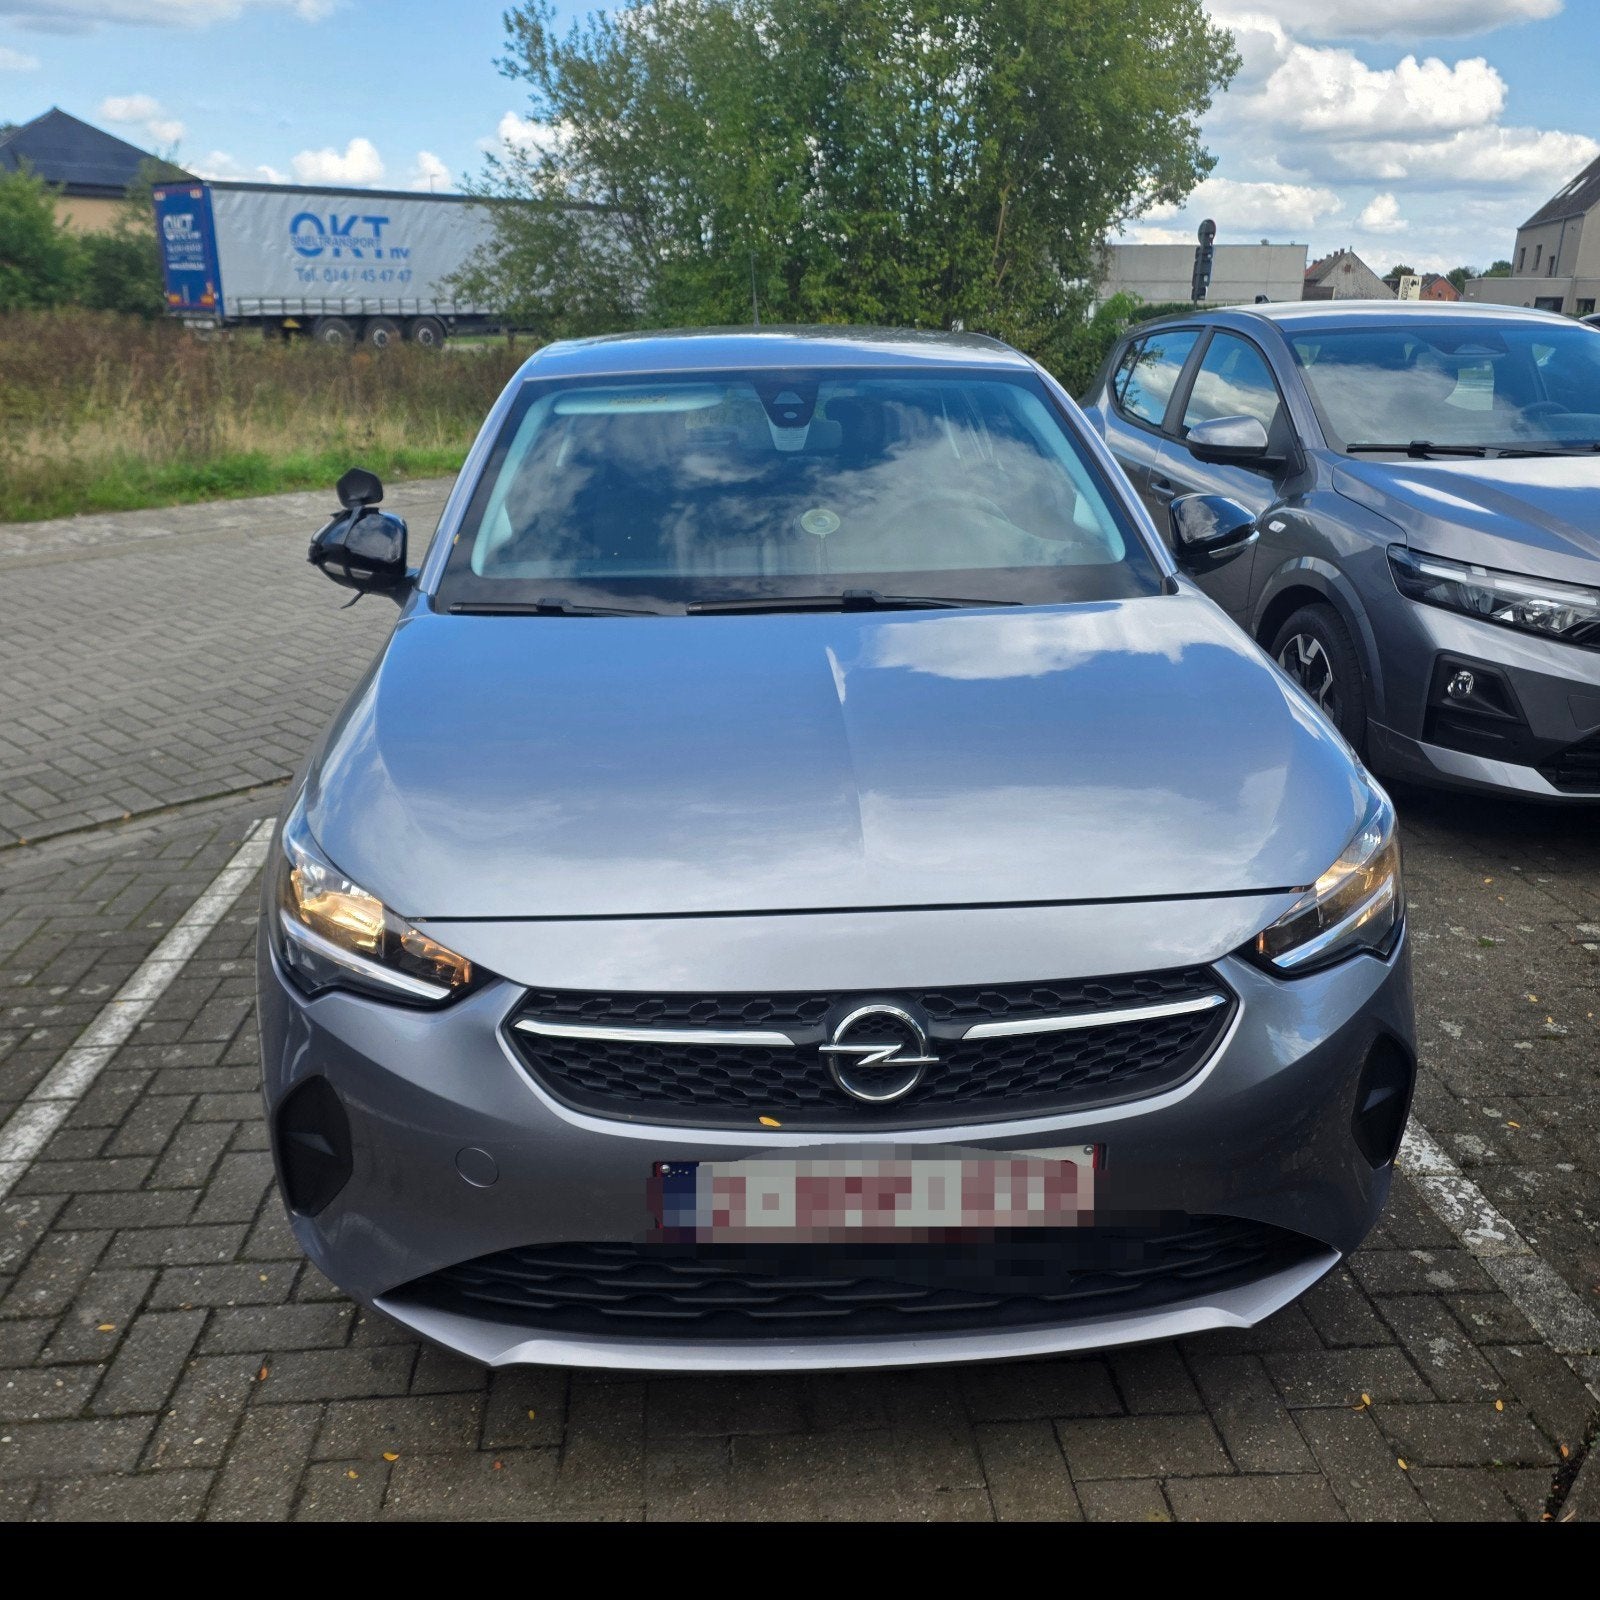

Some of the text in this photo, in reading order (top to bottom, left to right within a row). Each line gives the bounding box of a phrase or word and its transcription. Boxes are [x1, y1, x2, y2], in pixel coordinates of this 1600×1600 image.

[290, 212, 390, 258] OKT
[390, 247, 410, 259] nv
[294, 267, 318, 282] Tel.
[360, 268, 375, 282] 45
[379, 268, 394, 282] 47
[397, 268, 412, 283] 47
